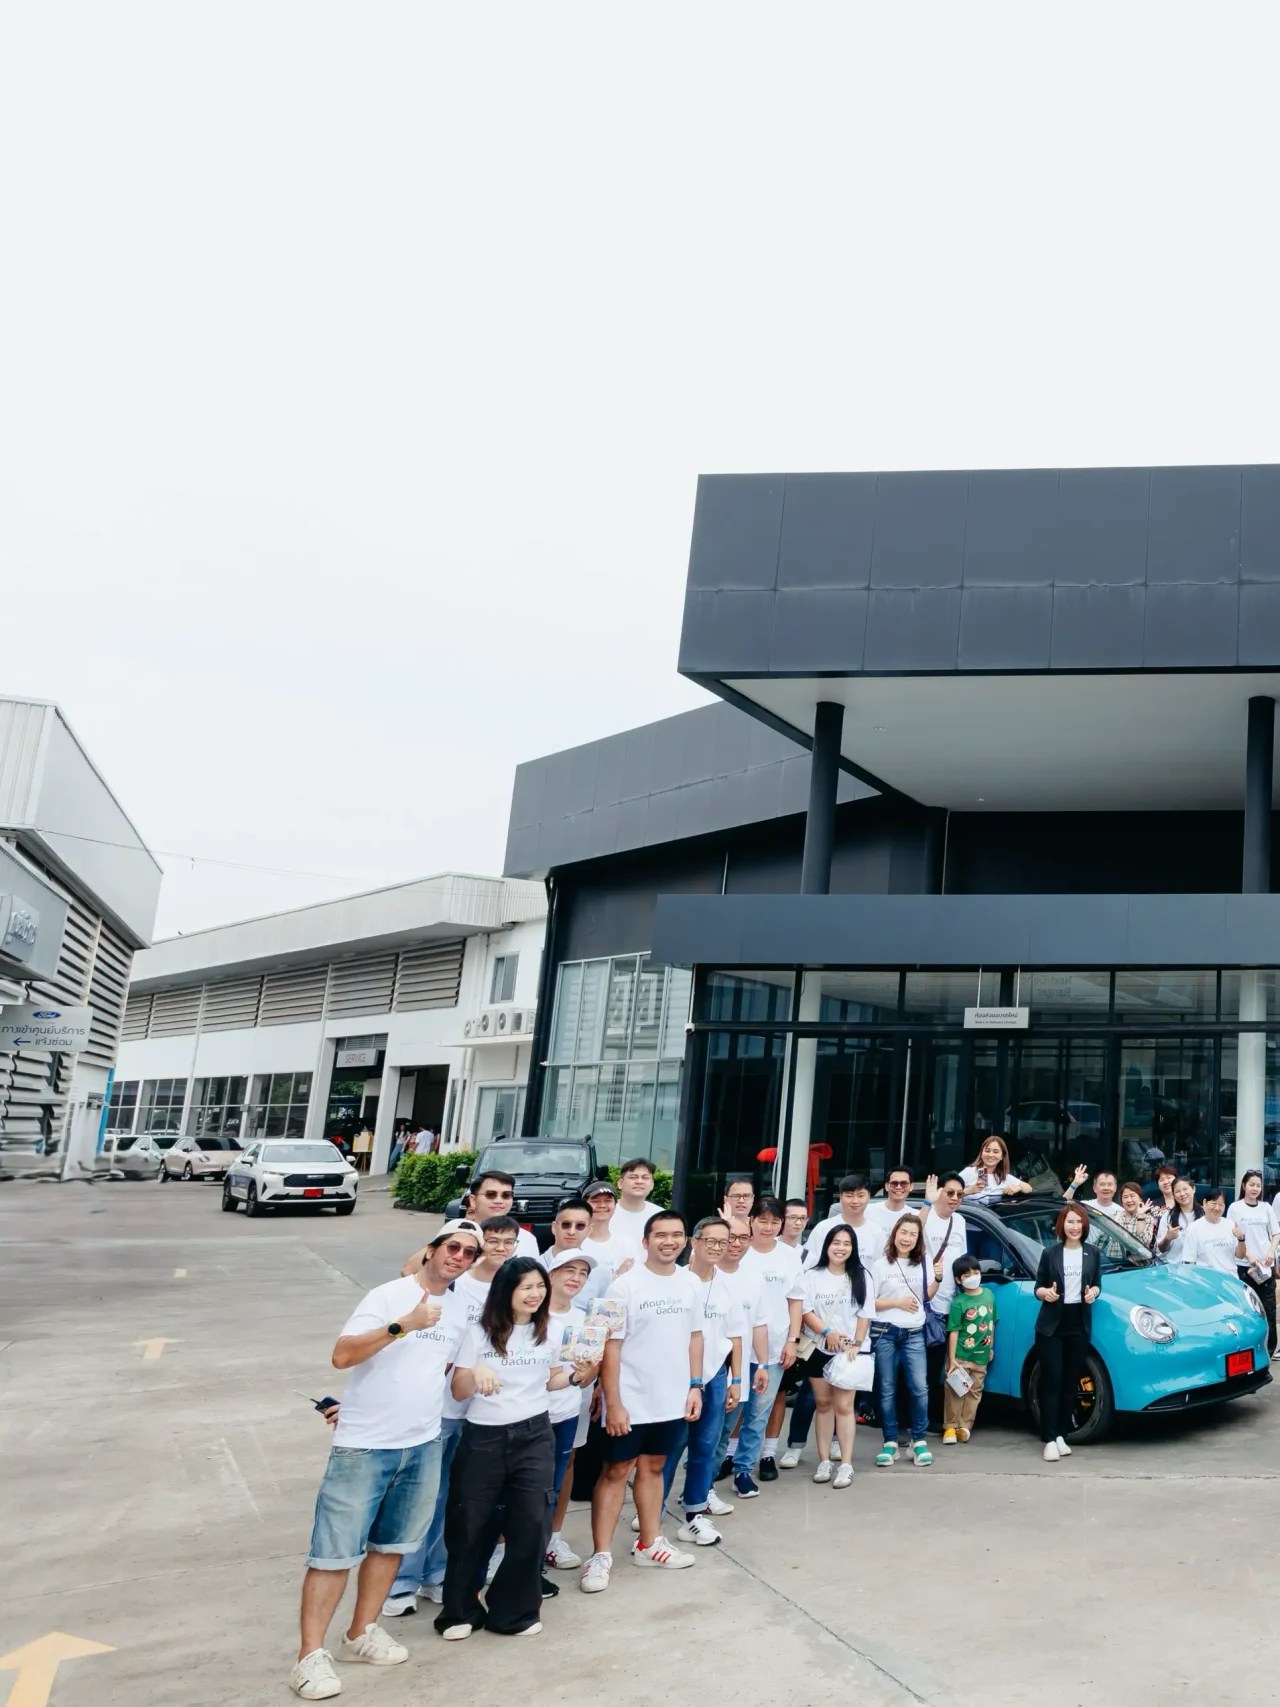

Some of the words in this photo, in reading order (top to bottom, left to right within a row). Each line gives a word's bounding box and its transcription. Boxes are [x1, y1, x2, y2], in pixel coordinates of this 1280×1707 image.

[1, 1025, 86, 1036] ทางเข้าศูนย์บริการ
[35, 1037, 73, 1046] แจ้งซ่อม
